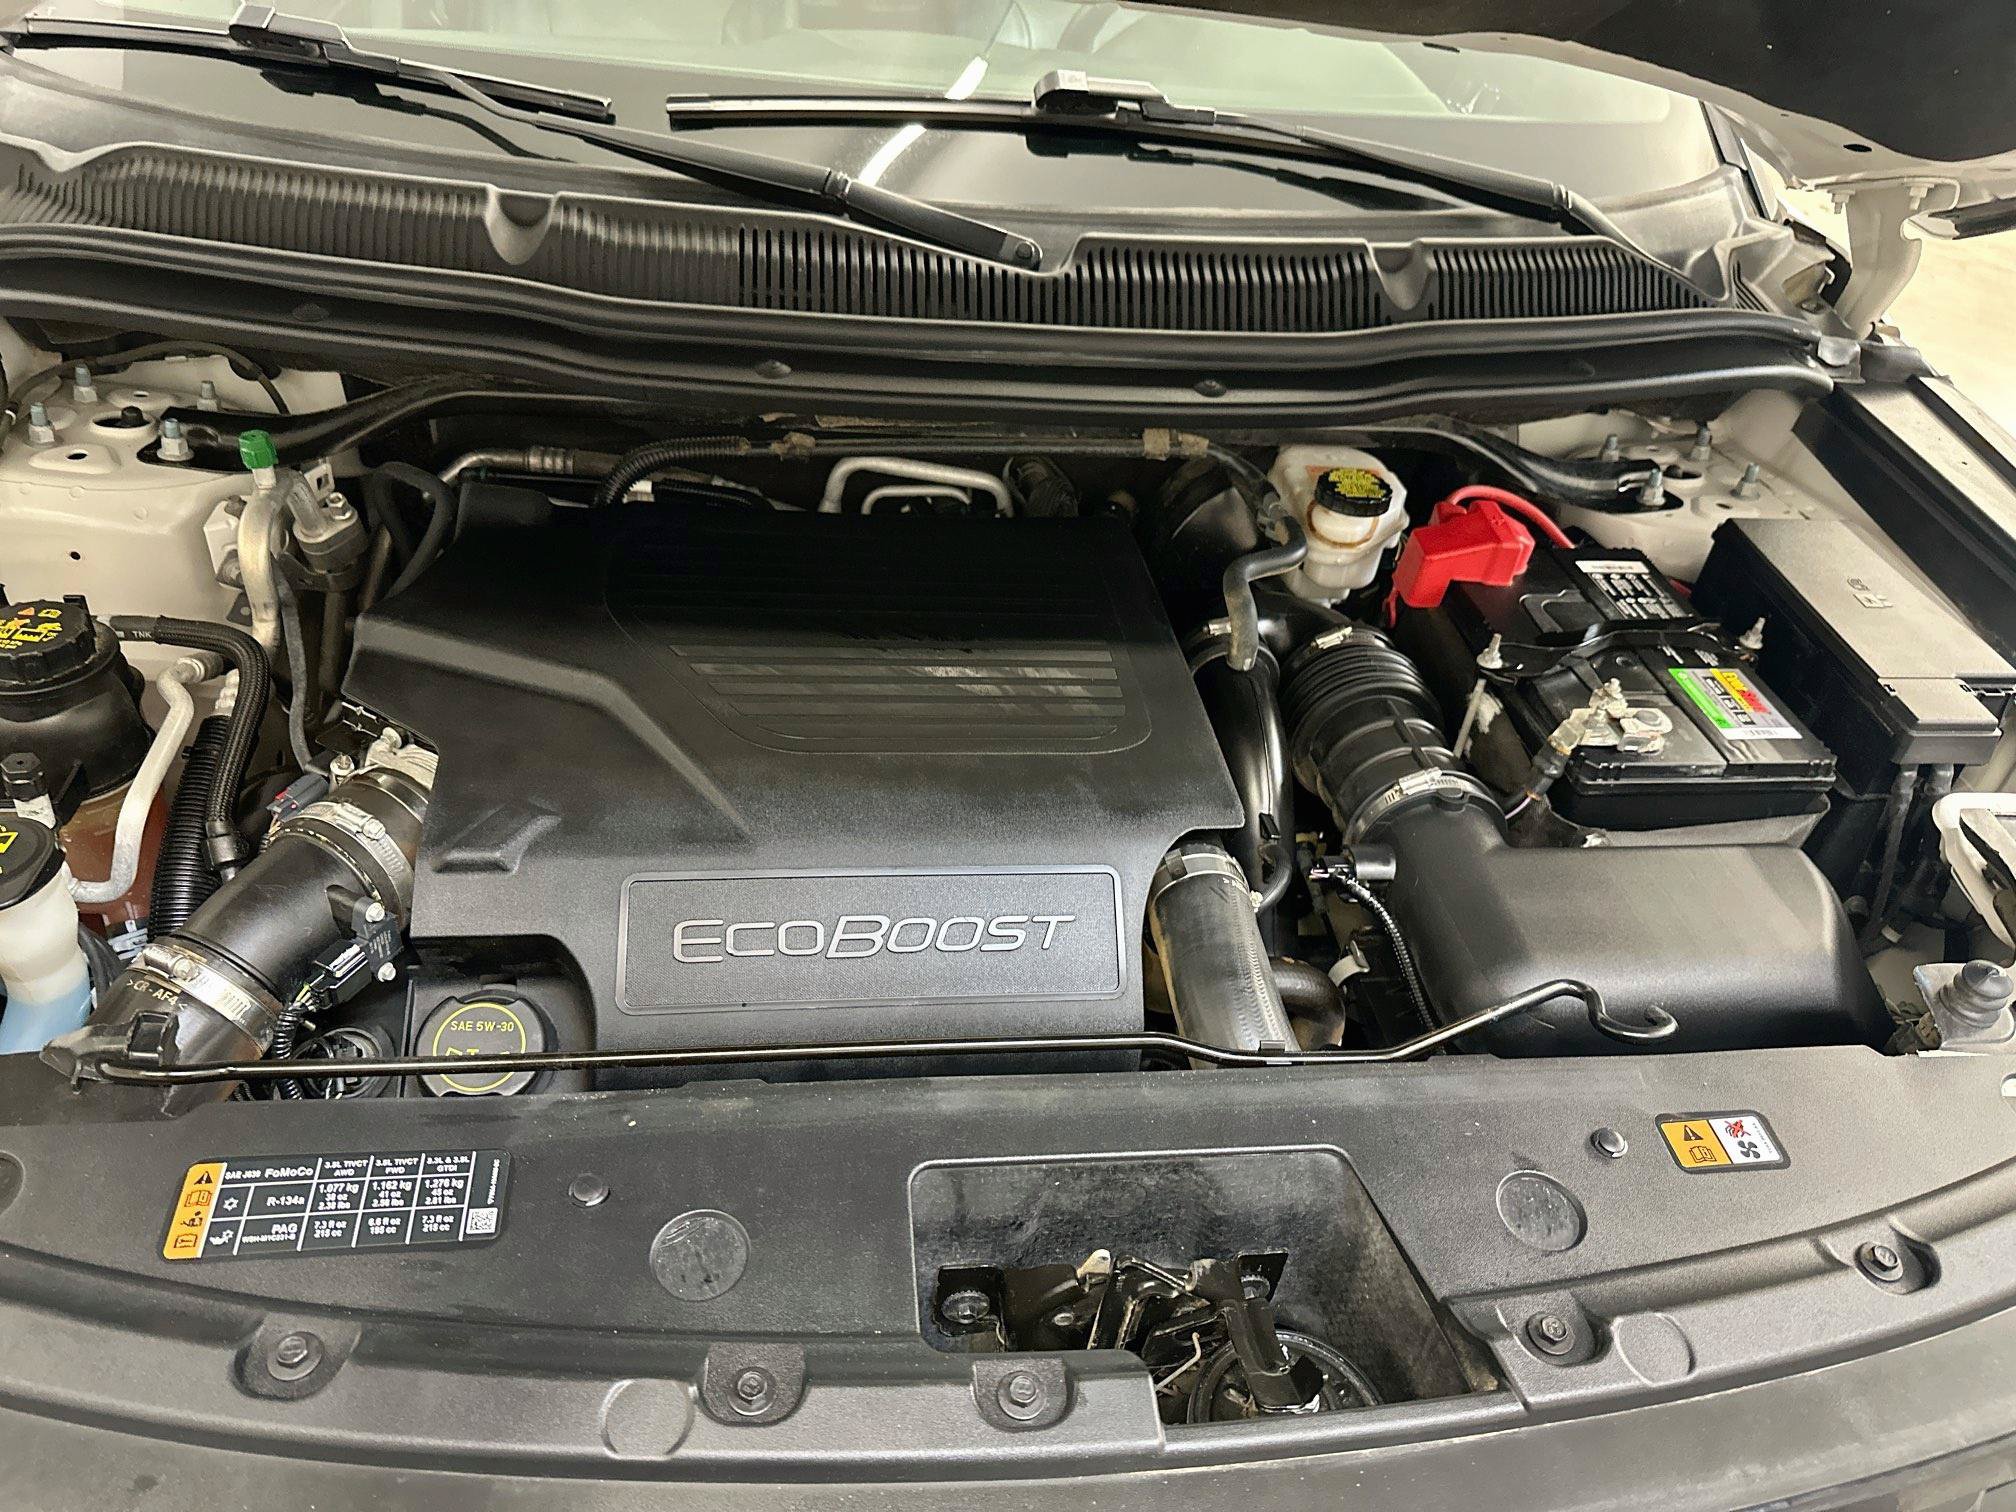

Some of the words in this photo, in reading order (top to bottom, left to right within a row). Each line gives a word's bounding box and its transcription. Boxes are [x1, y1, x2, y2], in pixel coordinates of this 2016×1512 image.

[132, 630, 152, 639] TNK
[450, 1020, 473, 1032] SAE
[476, 1021, 515, 1032] 5W-30
[264, 1166, 314, 1178] FoMoCo
[333, 1168, 355, 1177] AWD
[385, 1166, 406, 1175] FWD
[319, 1183, 345, 1194] 1.077
[346, 1182, 359, 1194] kg
[372, 1180, 399, 1191] 1.162
[399, 1180, 413, 1191] kg
[424, 1178, 451, 1189] 1.276
[451, 1177, 465, 1189] kg
[378, 1190, 390, 1198] 41
[266, 1195, 305, 1207] R-134a
[271, 1223, 298, 1235] PAG
